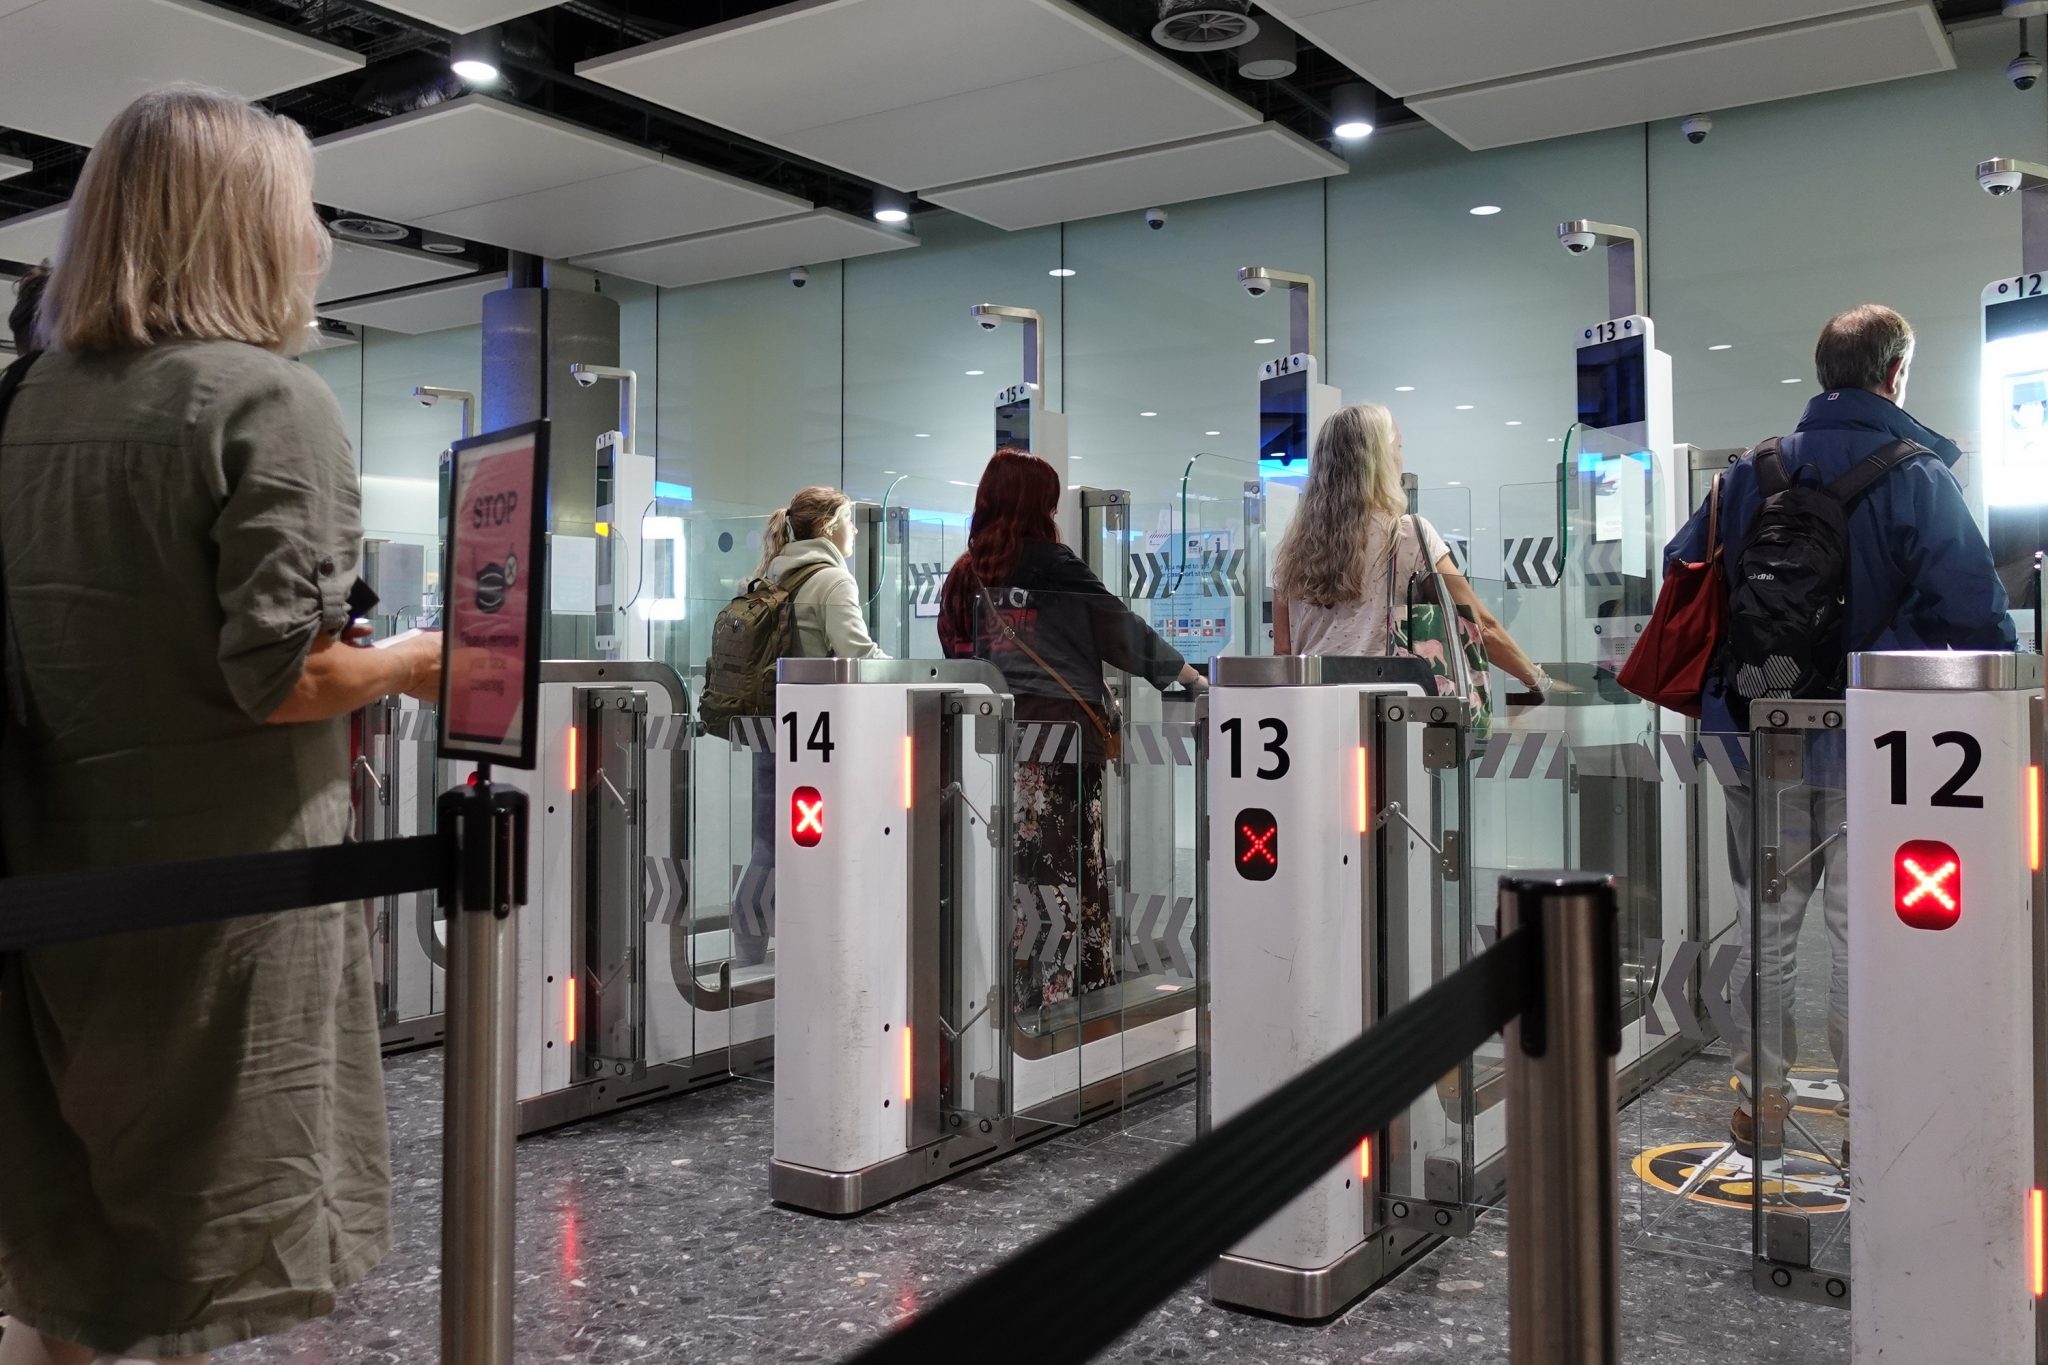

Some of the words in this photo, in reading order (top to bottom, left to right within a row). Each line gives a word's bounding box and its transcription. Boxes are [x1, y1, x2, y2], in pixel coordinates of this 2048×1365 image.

[2014, 273, 2042, 298] 12
[1596, 321, 1616, 343] 13
[1274, 356, 1289, 376] 14
[1006, 386, 1017, 403] 15
[472, 489, 519, 529] STOP
[1757, 573, 1775, 581] dhb
[781, 711, 835, 763] 14
[1219, 717, 1291, 781] 13
[1873, 730, 1984, 809] 12
